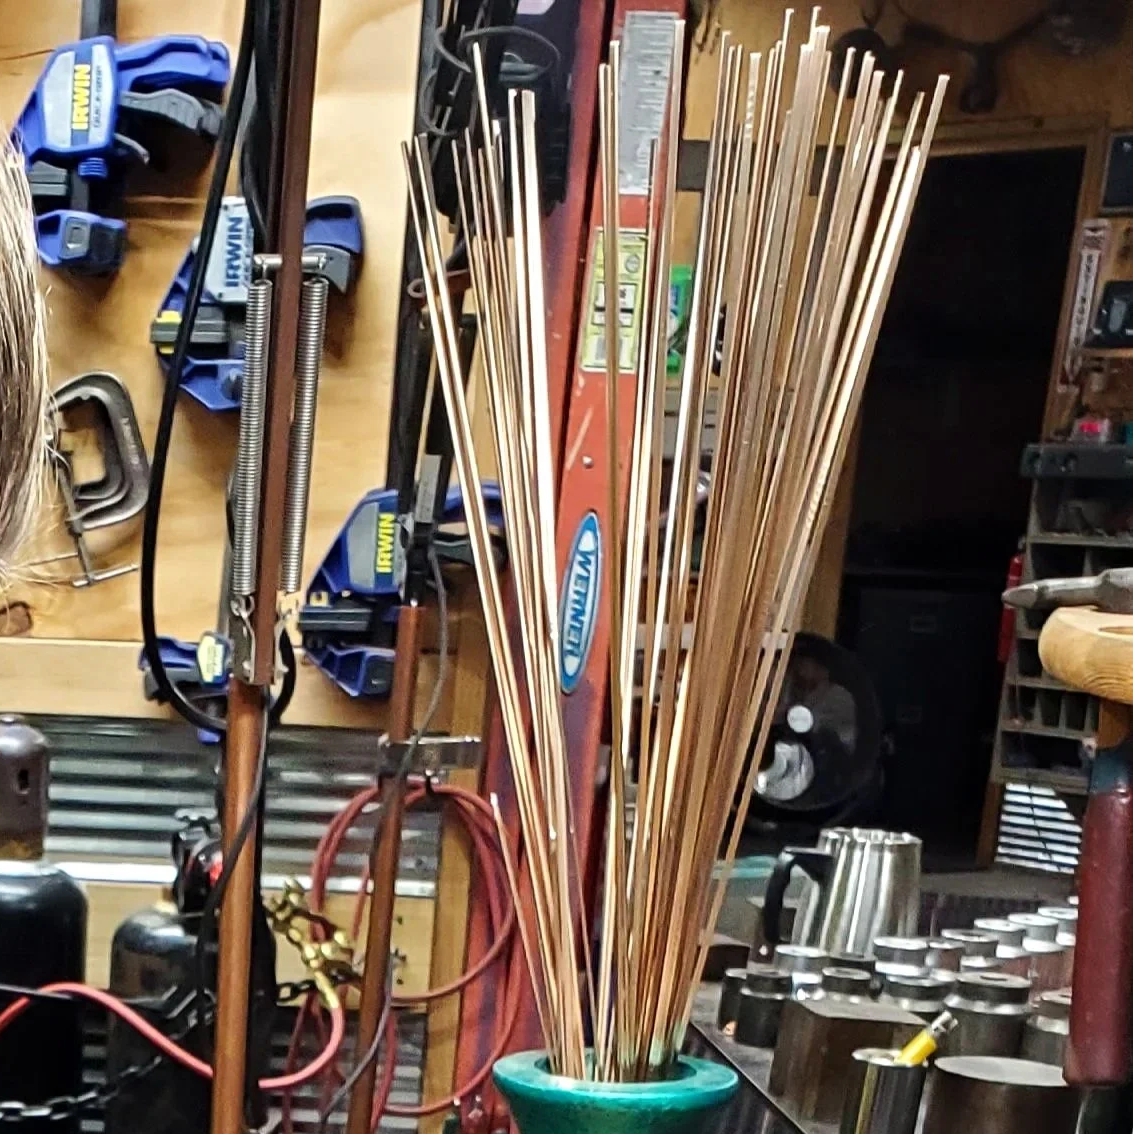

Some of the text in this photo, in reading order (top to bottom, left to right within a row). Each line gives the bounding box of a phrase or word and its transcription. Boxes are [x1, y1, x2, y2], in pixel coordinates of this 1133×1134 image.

[71, 64, 91, 130] IRWIN
[224, 216, 243, 287] IRWIN
[376, 512, 396, 573] IRWIN
[565, 548, 593, 658] WERNER
